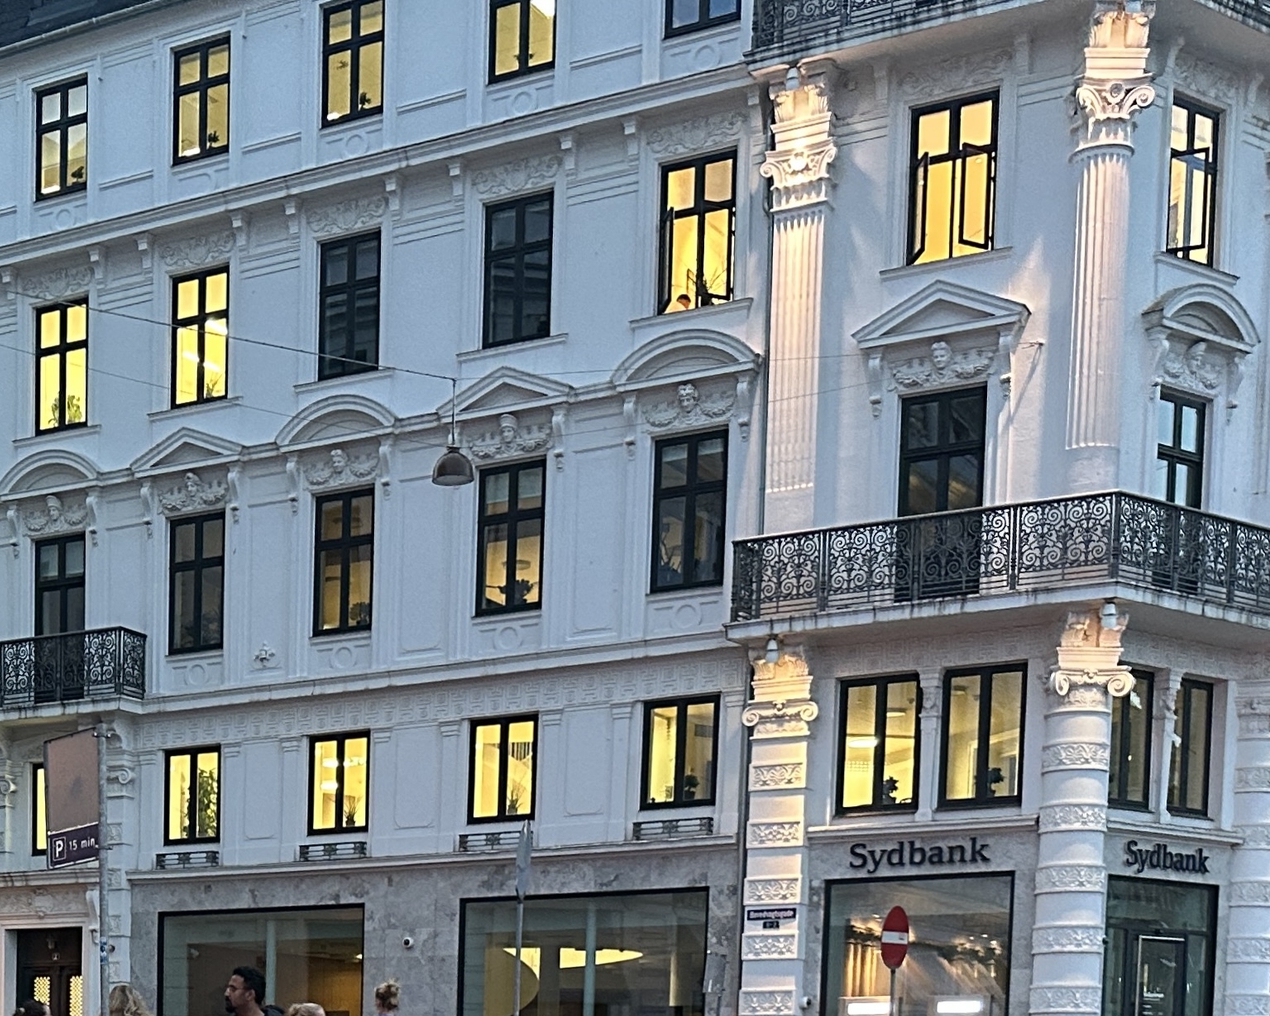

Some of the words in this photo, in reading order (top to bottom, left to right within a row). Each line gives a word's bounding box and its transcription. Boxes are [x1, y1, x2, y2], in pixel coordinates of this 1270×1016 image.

[55, 840, 64, 858] P
[69, 839, 78, 850] 15
[849, 837, 991, 874] Sydbank
[1126, 840, 1210, 874] Sydbank
